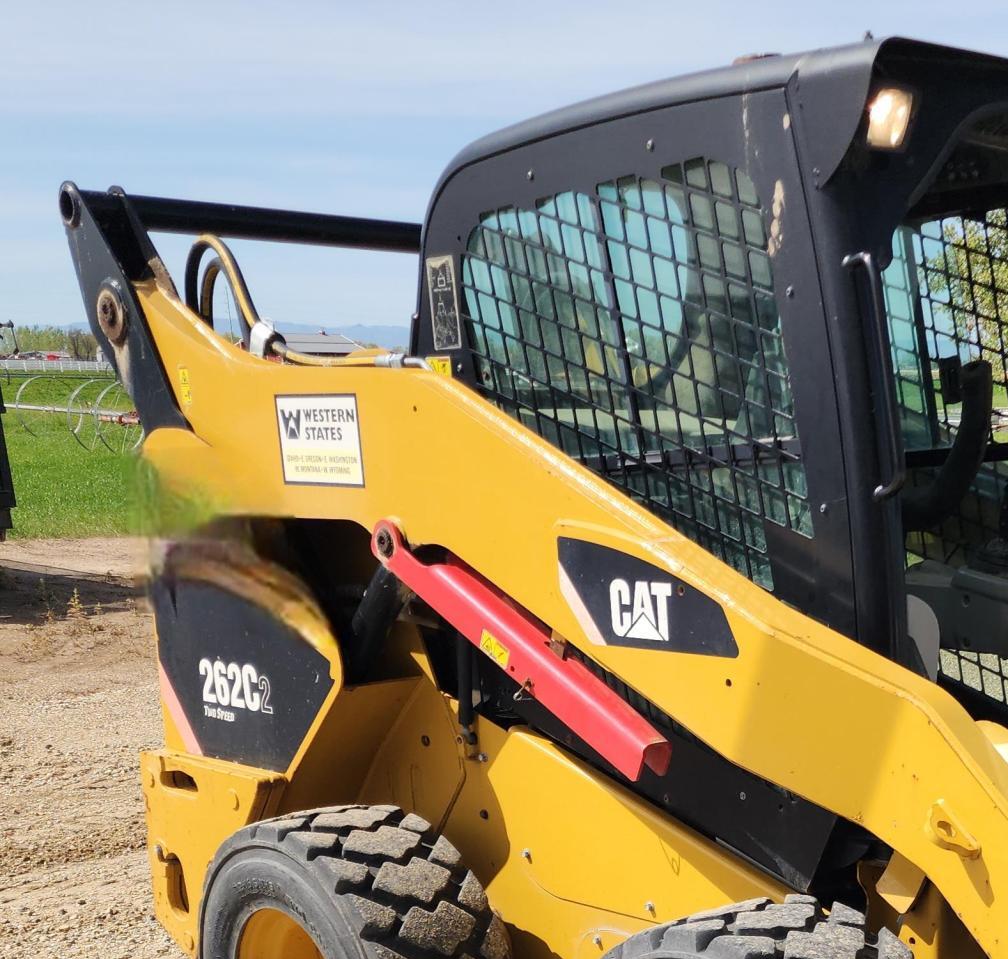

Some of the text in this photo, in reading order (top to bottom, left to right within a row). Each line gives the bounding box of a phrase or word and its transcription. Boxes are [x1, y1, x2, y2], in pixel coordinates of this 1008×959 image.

[303, 408, 355, 422] WESTERN
[305, 427, 343, 440] STATES
[609, 578, 672, 641] CAT
